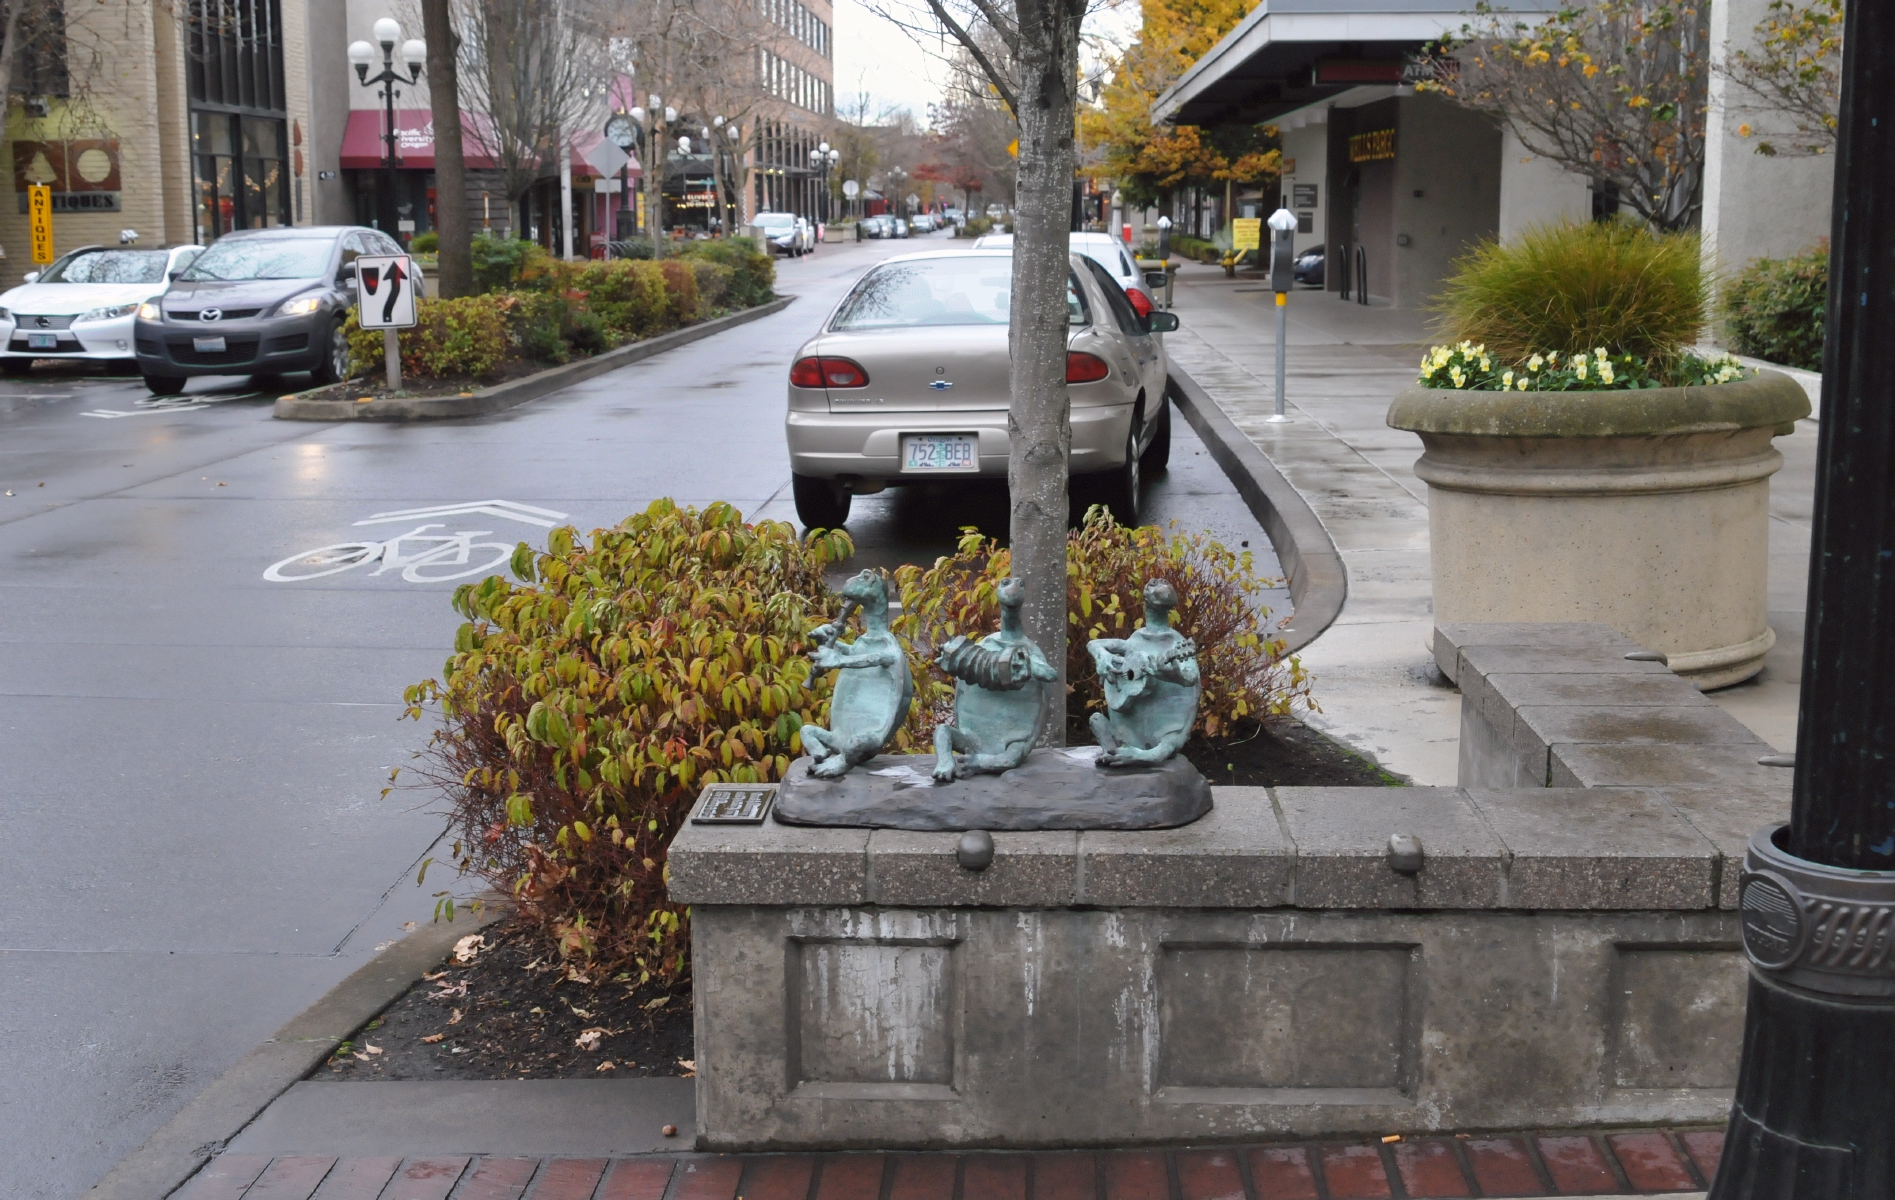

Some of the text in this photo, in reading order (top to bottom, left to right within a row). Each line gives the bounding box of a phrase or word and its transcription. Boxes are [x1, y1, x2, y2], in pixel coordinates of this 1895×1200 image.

[34, 190, 46, 260] ANTIQUES
[909, 443, 971, 461] 752 BEB
